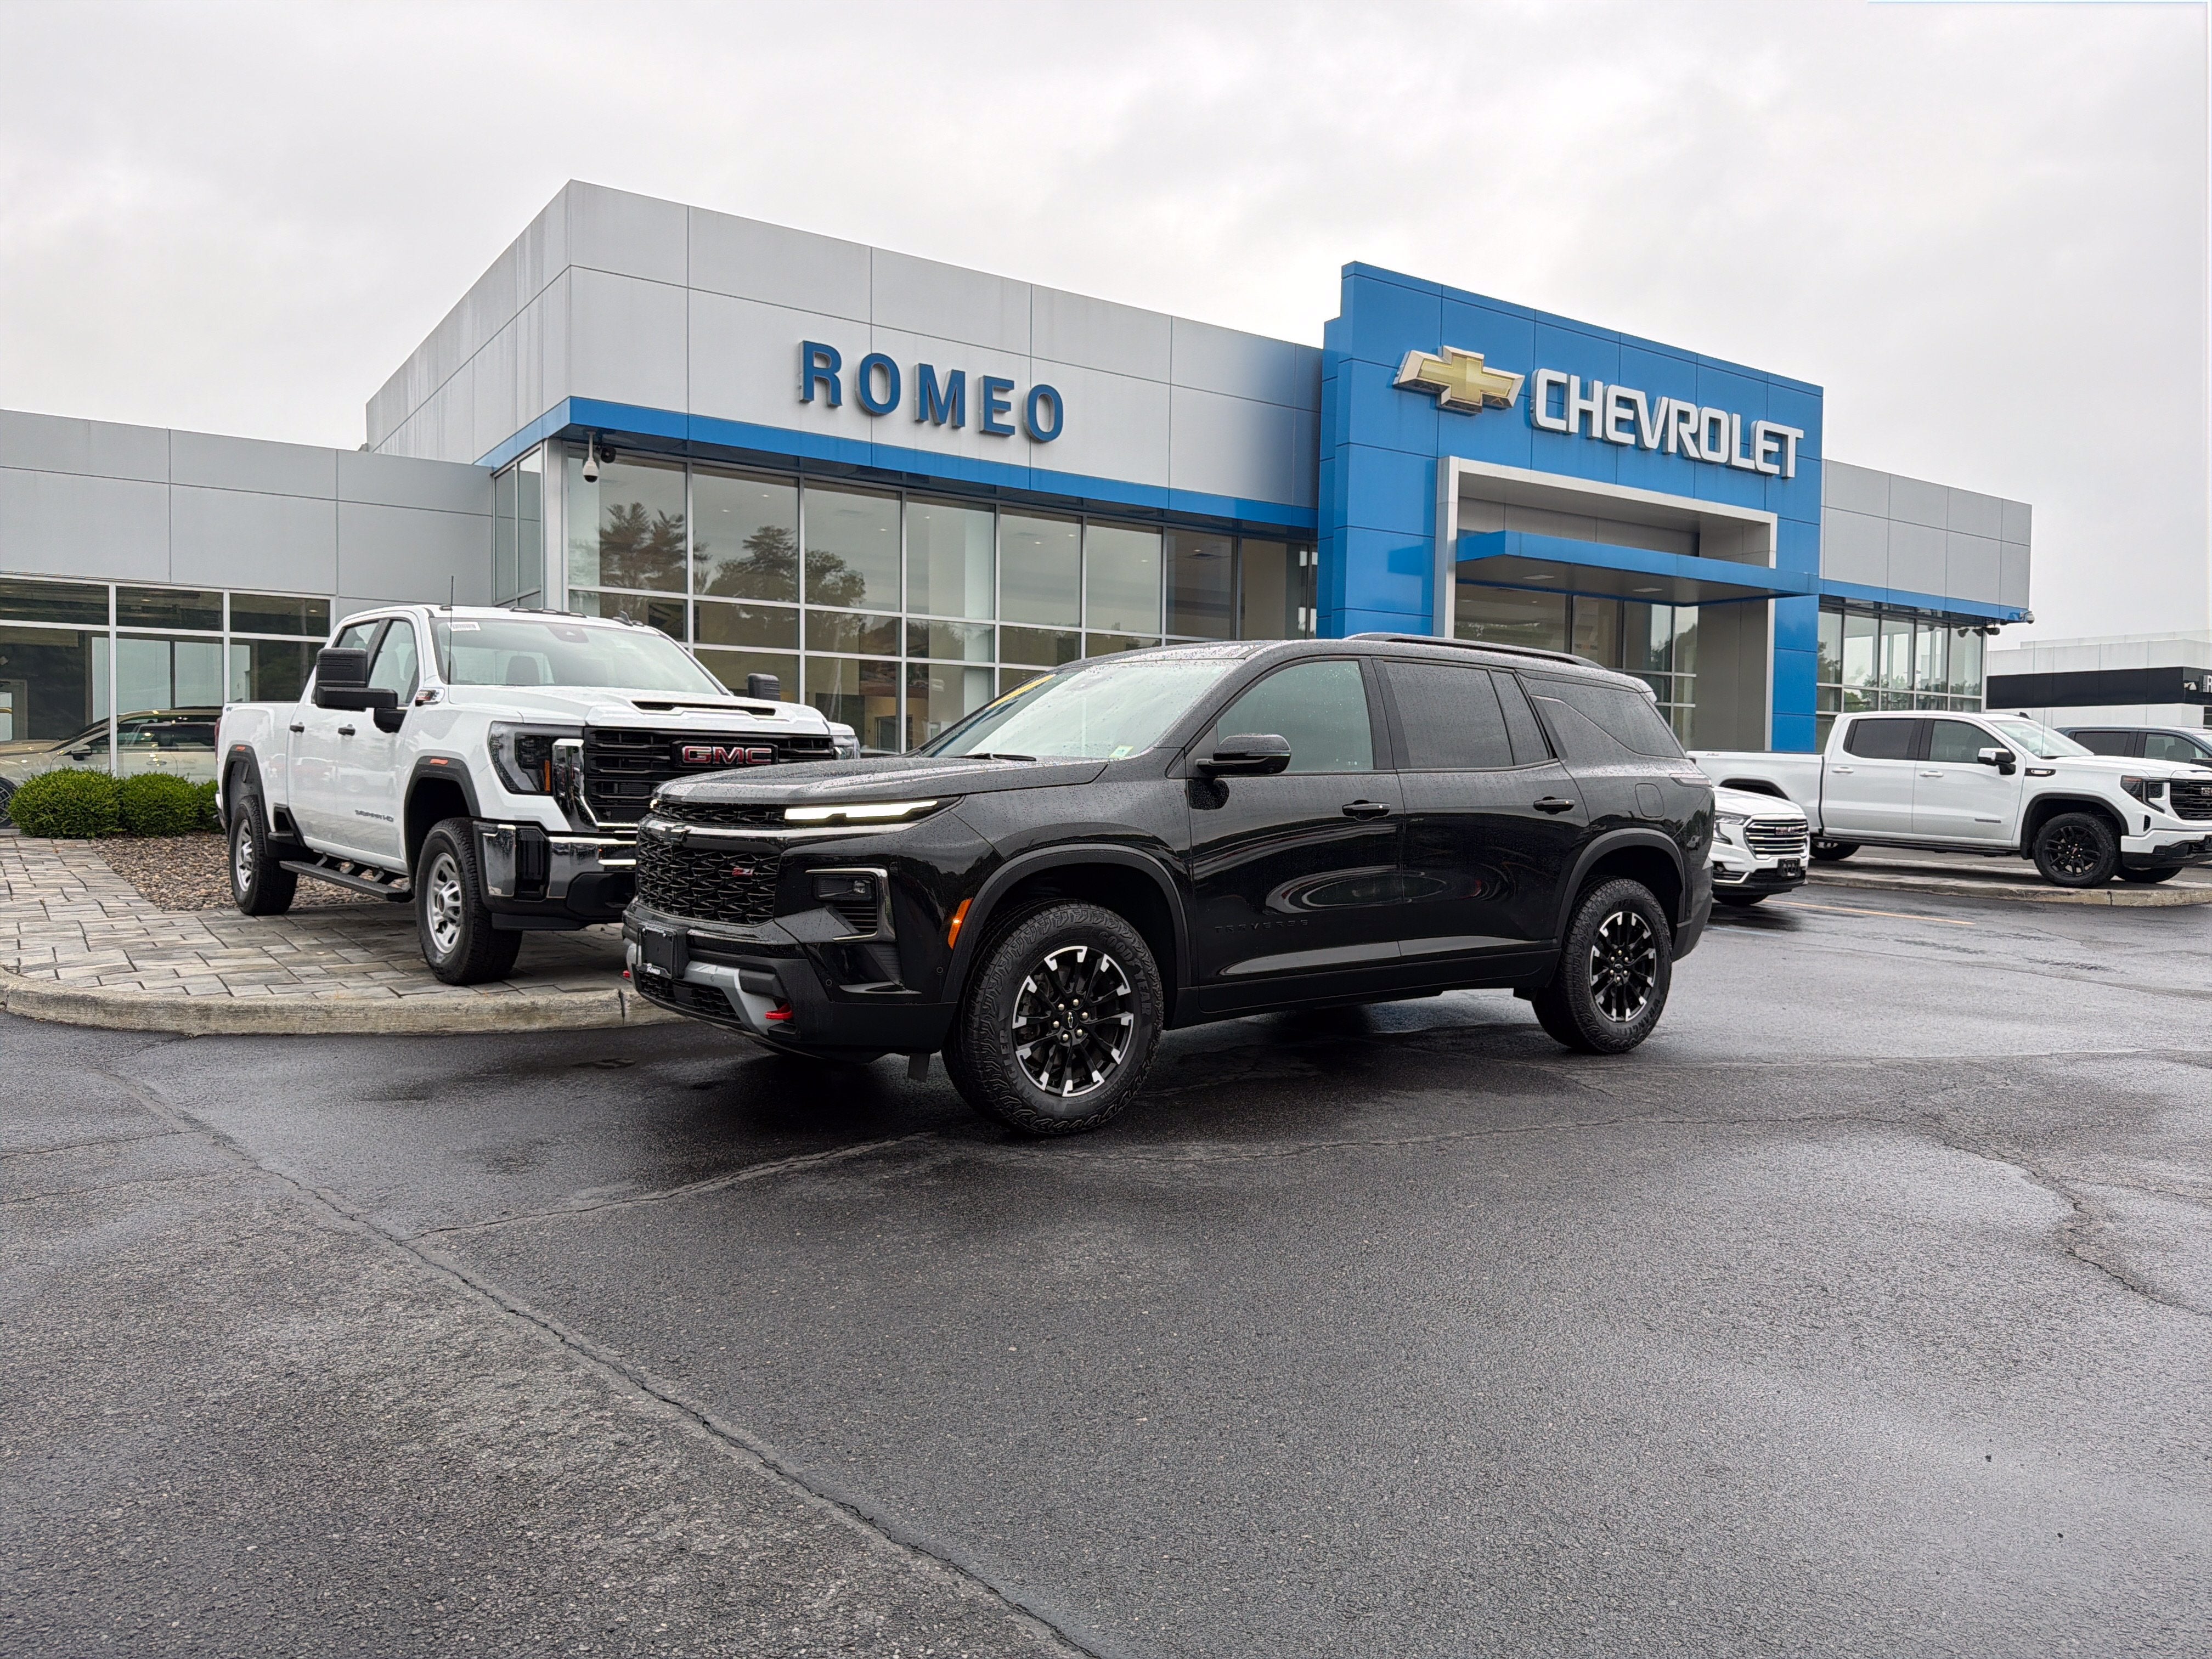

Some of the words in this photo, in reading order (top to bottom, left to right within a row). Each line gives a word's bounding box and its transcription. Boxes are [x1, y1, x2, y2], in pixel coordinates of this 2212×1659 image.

[799, 340, 1064, 443] ROMEO
[1531, 368, 1804, 478] CHEVROLET
[682, 746, 772, 765] GMC
[1098, 931, 1152, 1015] GOODYEAR
